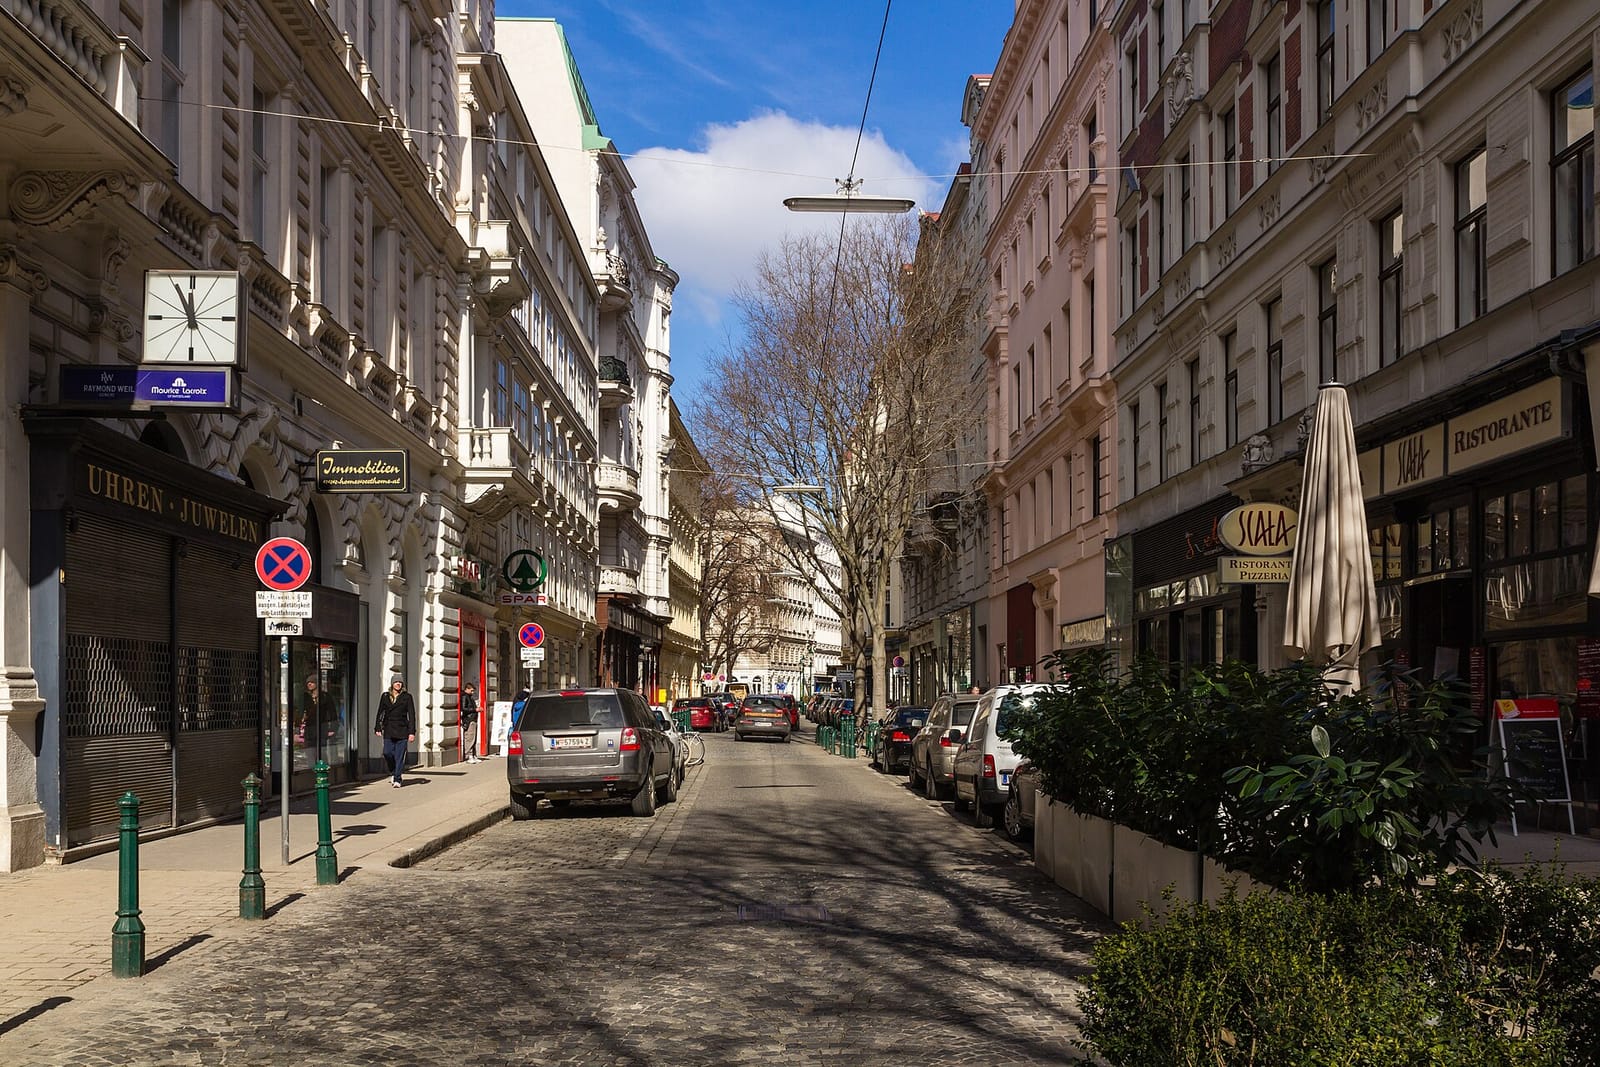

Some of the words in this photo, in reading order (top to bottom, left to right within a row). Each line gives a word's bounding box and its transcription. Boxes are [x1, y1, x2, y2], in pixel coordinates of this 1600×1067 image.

[83, 384, 117, 393] RAYMOND
[117, 384, 135, 393] WEIL
[151, 386, 179, 394] Maurice
[182, 386, 207, 395] Lacroix
[1454, 400, 1552, 455] RISTORANTE
[322, 457, 400, 474] Immobilien
[1397, 434, 1430, 486] SCALA
[88, 464, 164, 514] UHREN
[181, 498, 258, 543] JUWELEN
[1238, 510, 1296, 546] SCALA
[1230, 559, 1292, 568] RISTORANT
[1240, 571, 1289, 580] PIZZERIA
[502, 595, 546, 603] SPAR
